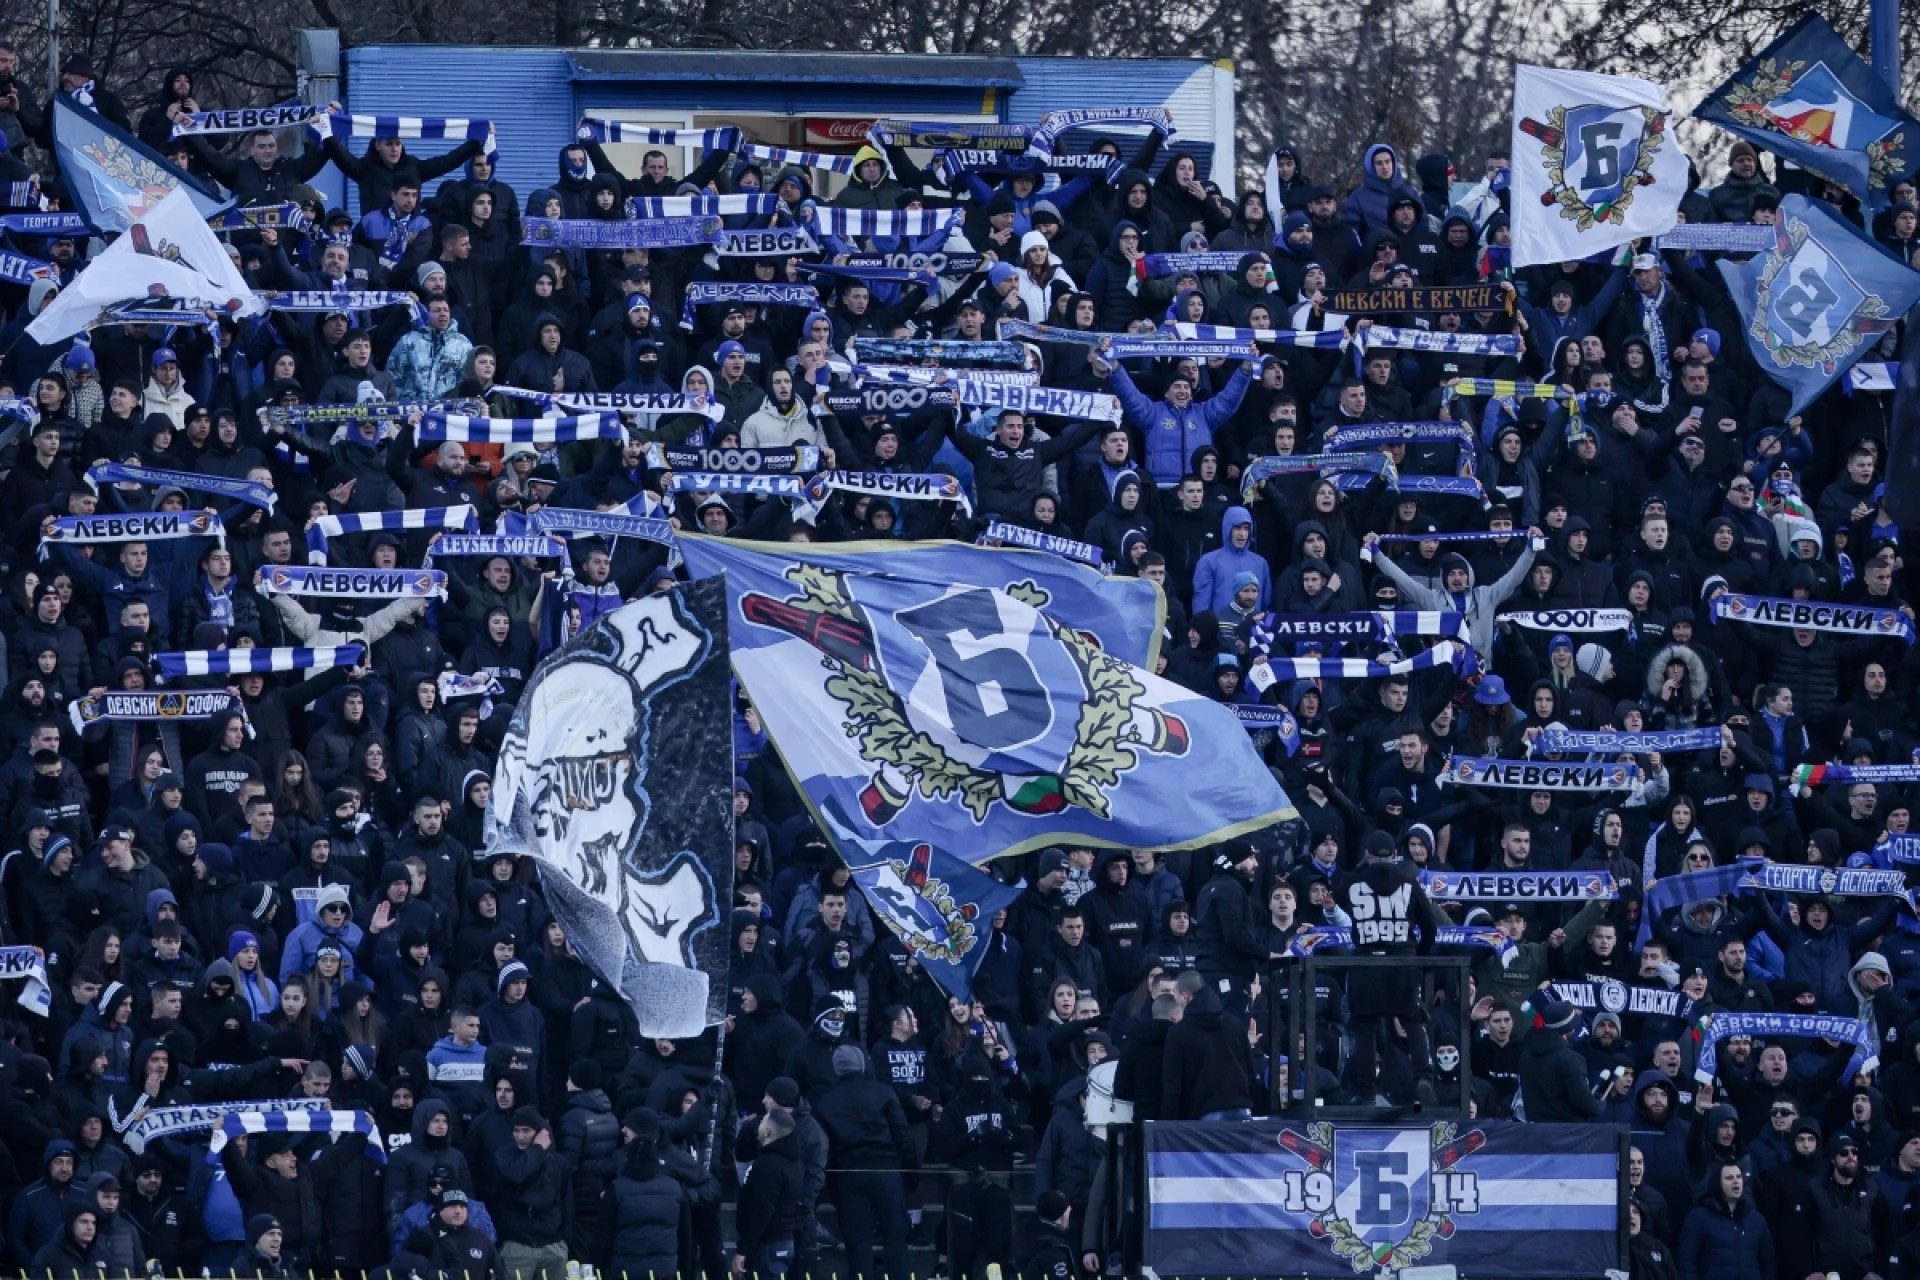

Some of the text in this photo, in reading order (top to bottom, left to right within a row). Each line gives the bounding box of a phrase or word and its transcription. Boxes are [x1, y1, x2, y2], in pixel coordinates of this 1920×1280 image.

[204, 105, 317, 130] ЛЕВСКИ
[960, 150, 998, 165] 1914
[1580, 121, 1623, 191] Б
[884, 252, 947, 272] 1000
[1335, 287, 1490, 310] ЛЕВСКИ Е ВЕЧЕН
[573, 392, 686, 409] ЛЕВСКИ
[862, 388, 929, 411] 1000
[962, 378, 1092, 415] ЛЕВСКИ
[699, 449, 762, 472] 1000
[829, 470, 931, 495] ЛЕВСКИ
[74, 515, 180, 538] ЛЕВСКИ
[442, 536, 549, 554] LEVSKI SOFIA
[987, 520, 1092, 560] LEVSKI SOFIA
[303, 572, 404, 595] ЛЕВСКИ
[1277, 620, 1372, 635] ЛЕВСКИ
[1754, 600, 1875, 631] ЛЕВСКИ
[894, 588, 1055, 751] Б
[107, 693, 231, 715] ЛЕВСКИ СОФИЯ
[1482, 762, 1603, 788] ЛЕВСКИ
[1458, 875, 1580, 899] ЛЕВСКИ
[1765, 865, 1817, 891] ГЕОРГИ
[1357, 920, 1410, 945] 1999
[1629, 987, 1681, 1017] ЛЕВСКИ
[1711, 1016, 1782, 1035] ЛЕВСКИ
[1789, 1018, 1857, 1038] СОФИЯ
[1284, 1151, 1481, 1228] 19 Б 14
